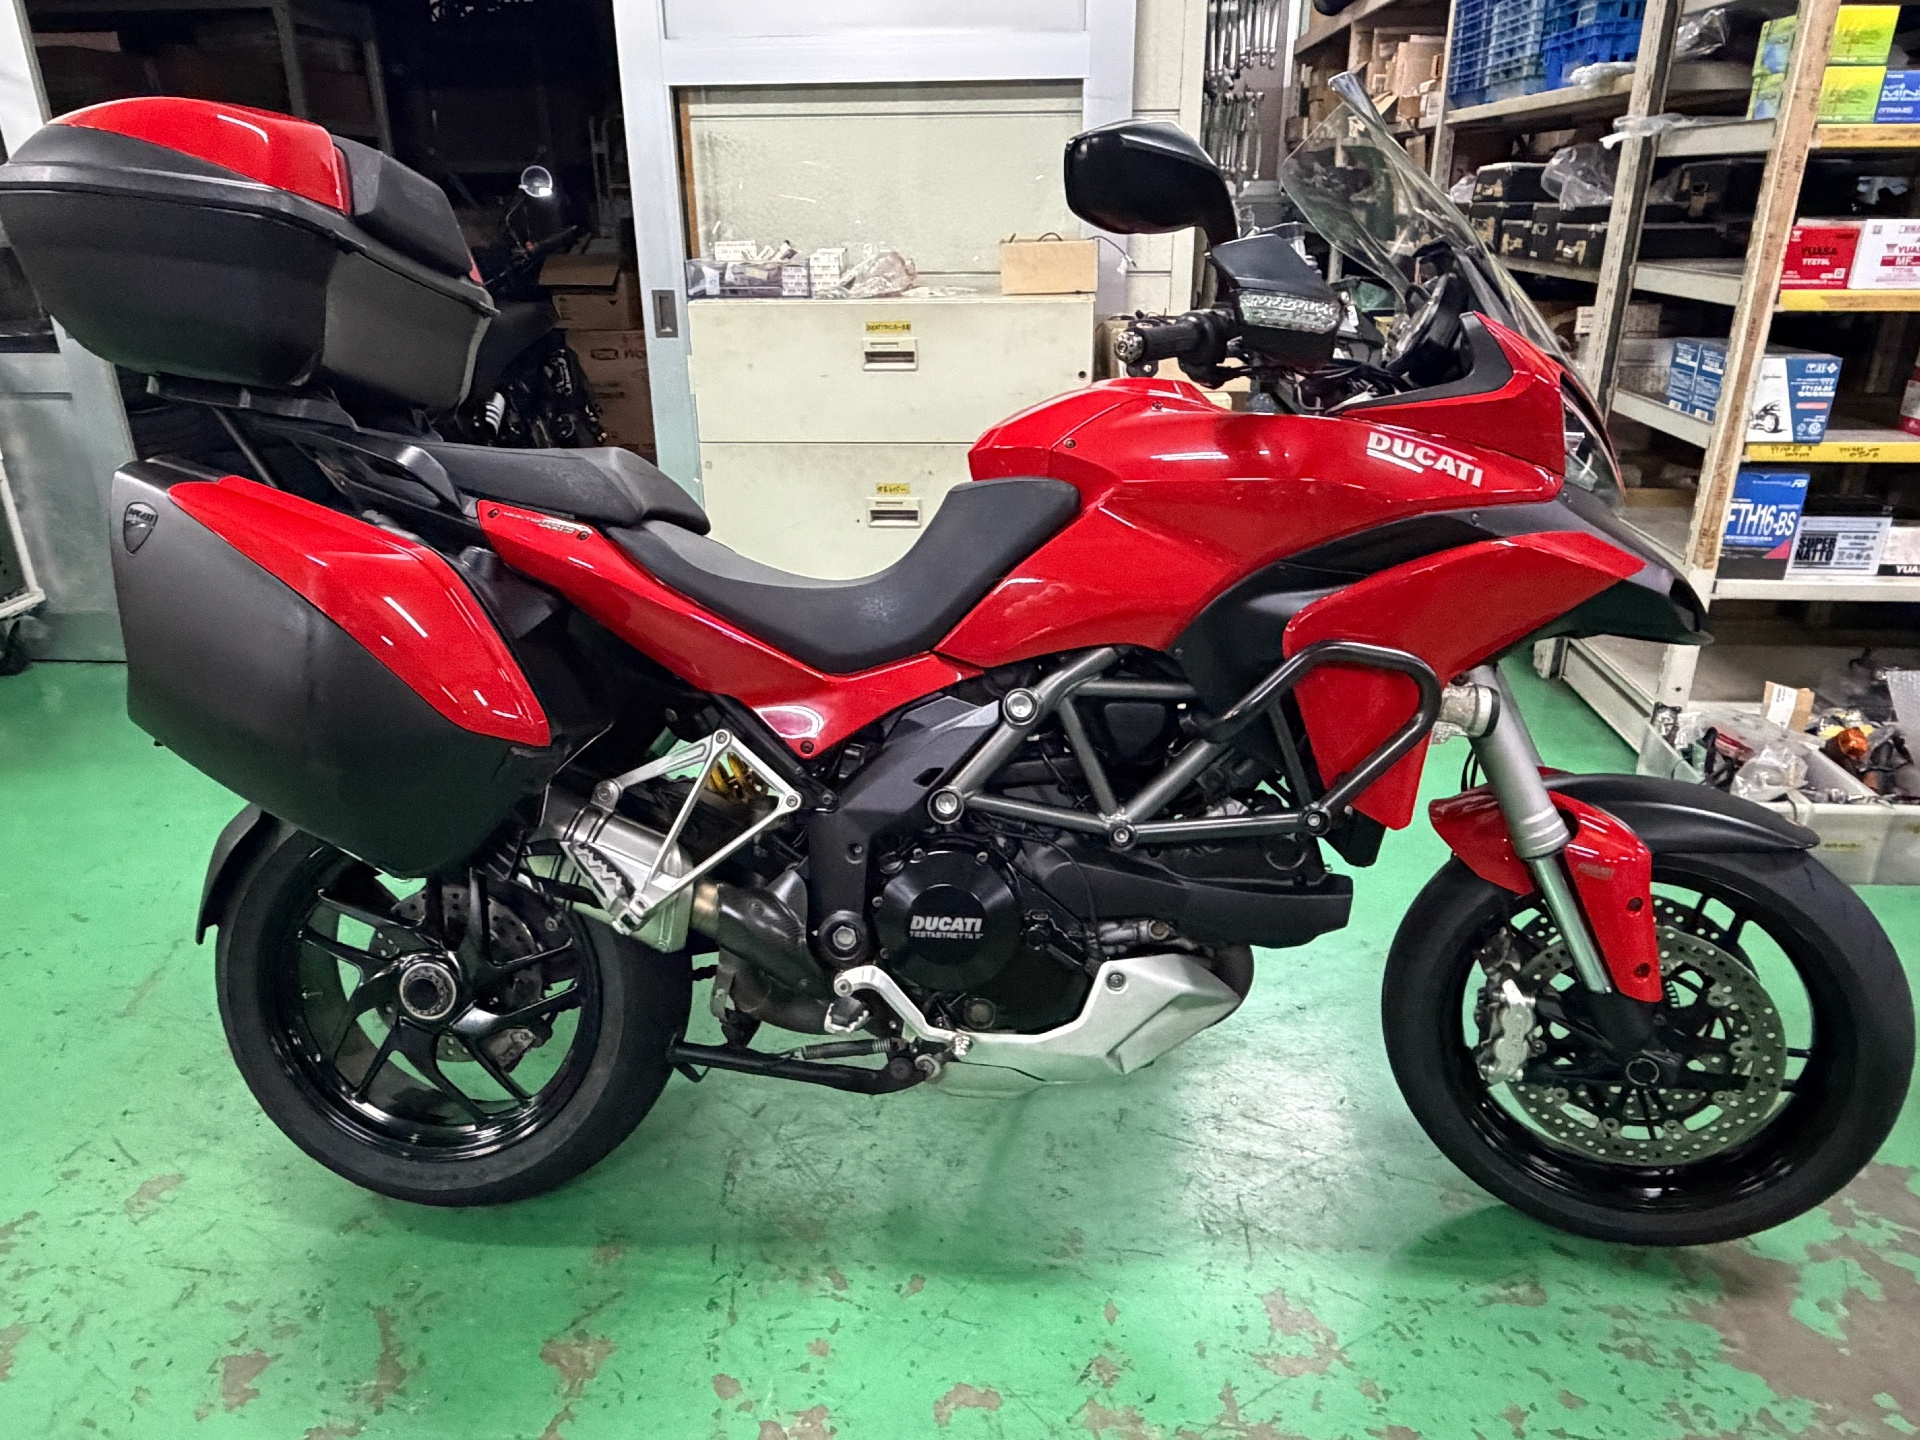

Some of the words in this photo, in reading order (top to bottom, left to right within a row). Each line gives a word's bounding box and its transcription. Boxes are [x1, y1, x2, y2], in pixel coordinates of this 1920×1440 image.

[1801, 246, 1838, 256] YUASA
[1366, 431, 1484, 488] DUCATI
[1725, 502, 1797, 537] FTH16-BS
[1798, 536, 1838, 550] SUPER
[1794, 548, 1835, 562] NATTO
[1896, 564, 1920, 574] YUA
[910, 915, 983, 932] DUCATI
[909, 931, 974, 940] TESTASTRETTA
